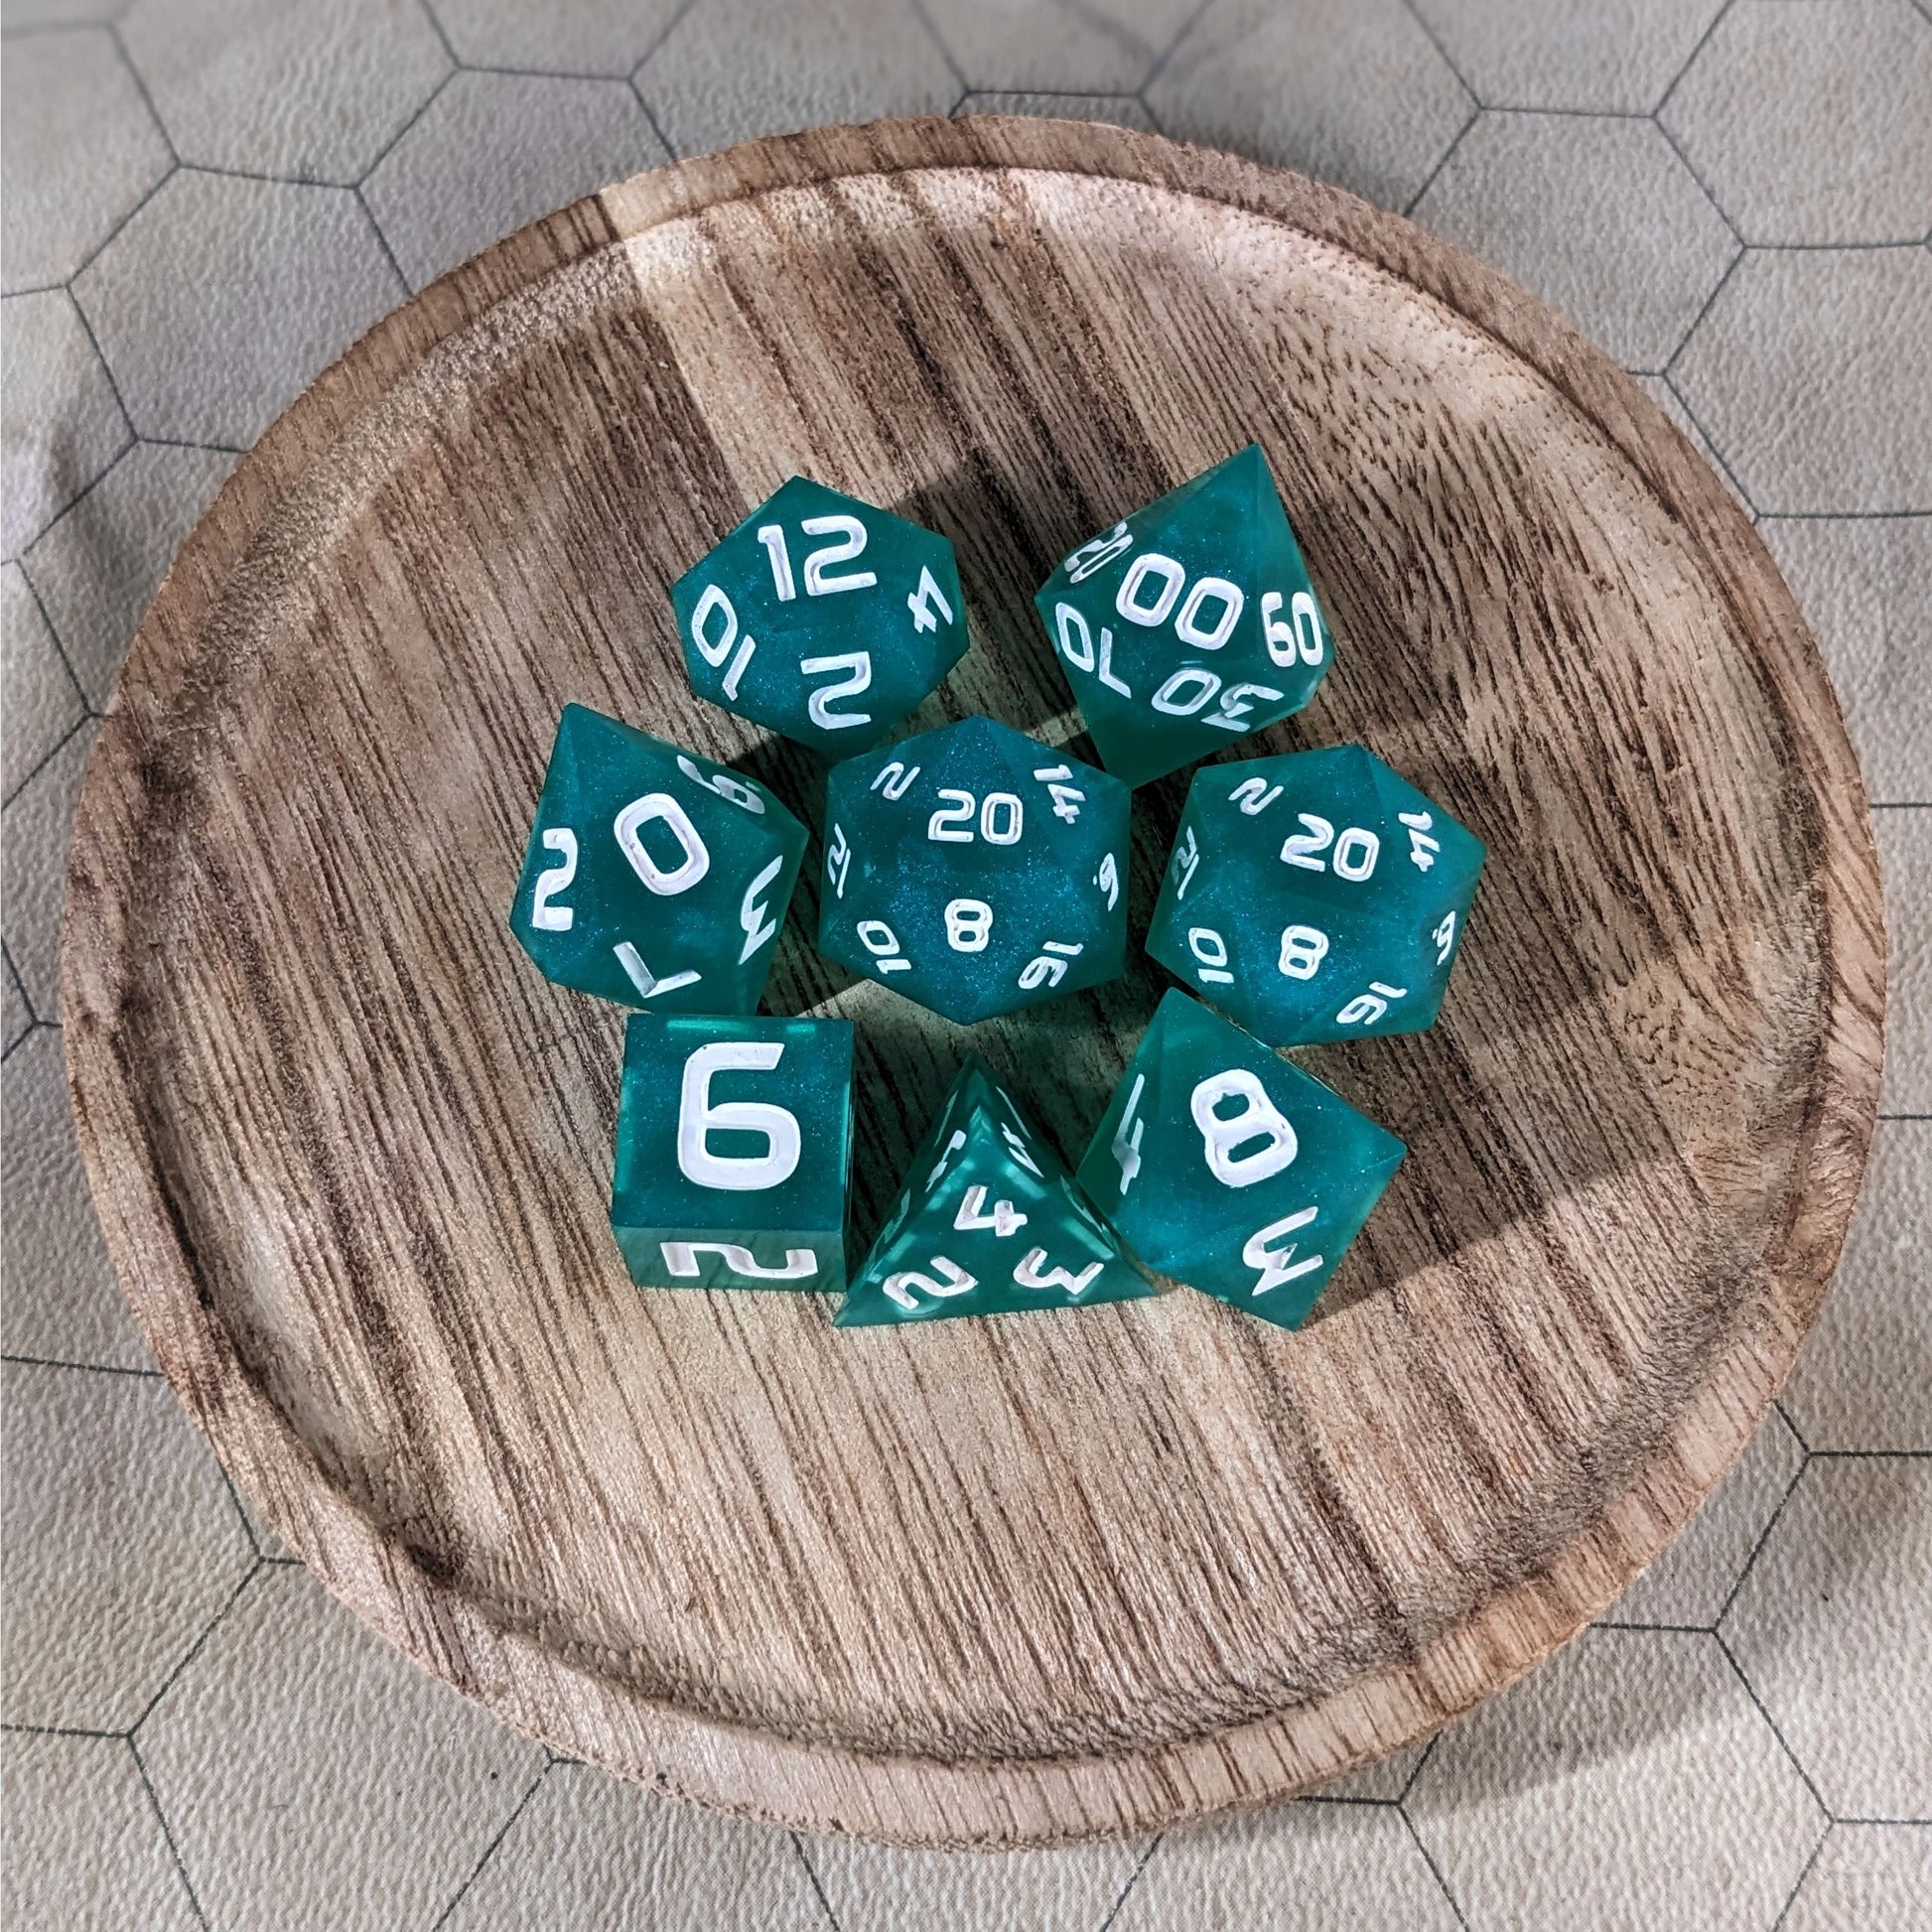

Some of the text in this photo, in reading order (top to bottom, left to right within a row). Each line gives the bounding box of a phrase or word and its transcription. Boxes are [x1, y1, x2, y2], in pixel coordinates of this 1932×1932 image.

[758, 515, 877, 601] 12
[1065, 521, 1136, 586] 20
[907, 566, 952, 632] 4
[1114, 551, 1244, 649] 00
[1261, 590, 1323, 667] 60
[690, 585, 756, 702] 10
[1055, 601, 1133, 698] 70
[801, 651, 871, 730] 2
[1152, 670, 1284, 731] 30
[871, 762, 920, 800] 2
[1034, 764, 1085, 823] 14
[1229, 777, 1284, 815] 2
[614, 793, 709, 896] 0
[928, 789, 1023, 845] 20
[1281, 813, 1380, 882] 20
[1399, 812, 1440, 872] 14
[532, 828, 578, 931] 2
[740, 856, 782, 964] 3
[857, 920, 911, 974] 10
[944, 898, 993, 952] 8
[1188, 928, 1233, 983] 10
[1278, 925, 1328, 980] 8
[614, 942, 701, 998] 7
[1019, 941, 1083, 989] 16
[1336, 982, 1407, 1025] 16
[677, 1042, 801, 1190] 6
[1112, 1073, 1145, 1195] 4
[1190, 1069, 1298, 1188] 8
[953, 1185, 1028, 1236] 4
[660, 1242, 818, 1280] 2
[1013, 1248, 1104, 1295] 3
[1243, 1206, 1325, 1299] 3
[883, 1257, 978, 1311] 2
